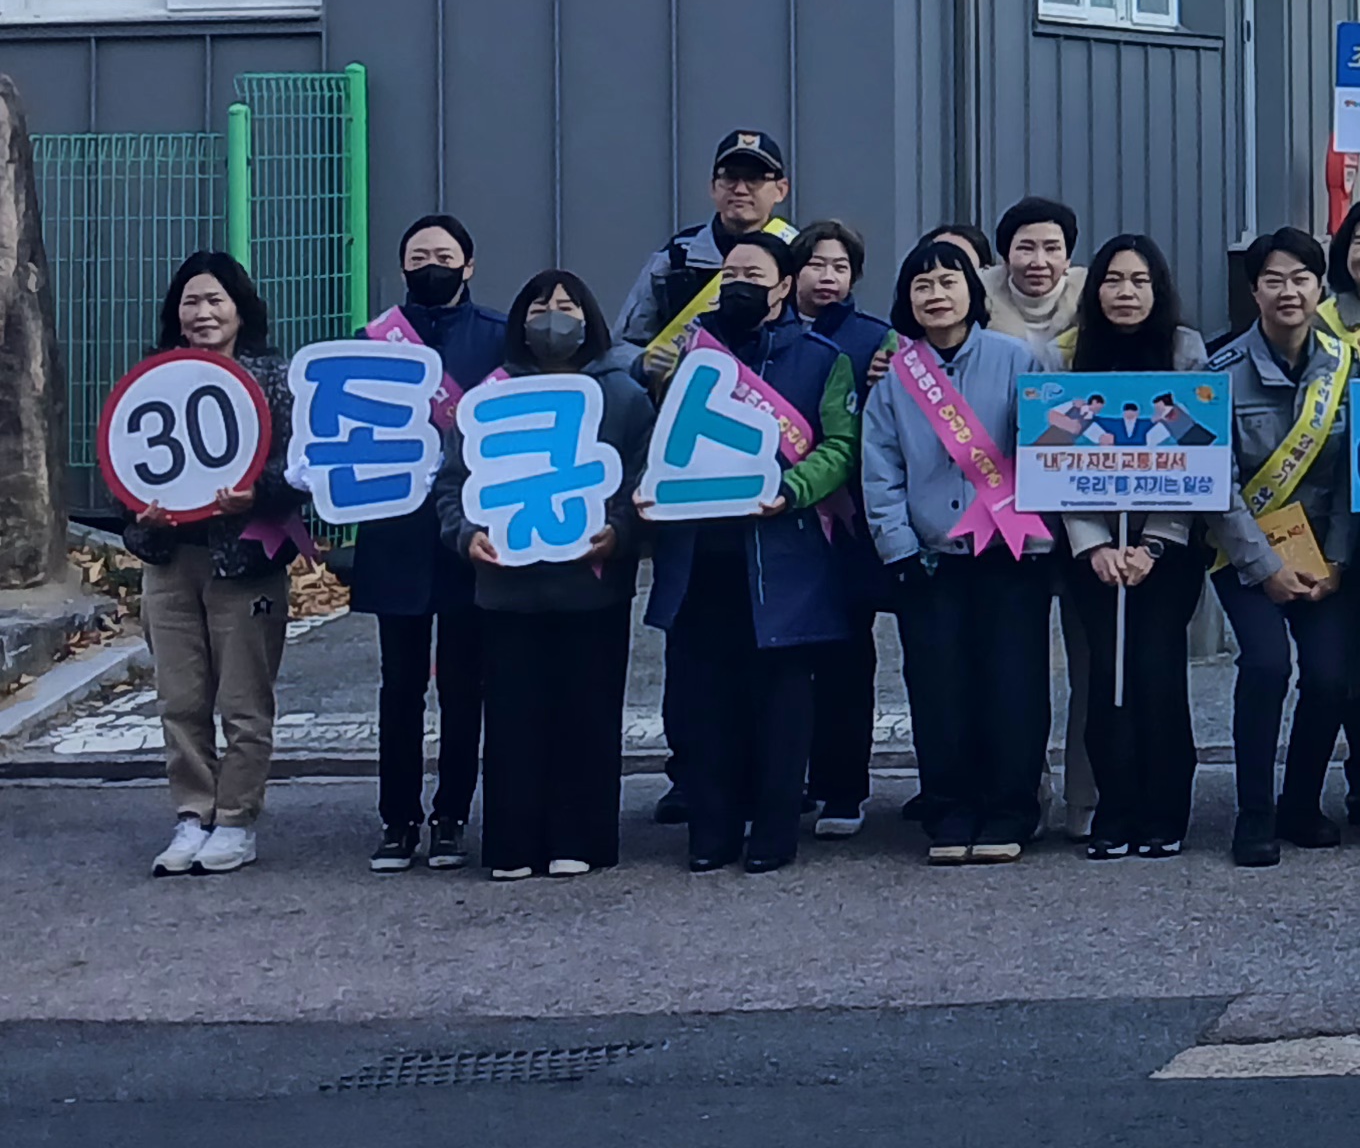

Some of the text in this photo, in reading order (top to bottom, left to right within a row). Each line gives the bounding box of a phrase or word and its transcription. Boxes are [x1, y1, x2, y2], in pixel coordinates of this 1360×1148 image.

[127, 383, 241, 486] 30
[304, 355, 427, 509] 존
[656, 362, 766, 504] 스
[1121, 452, 1153, 472] 교통
[1155, 451, 1188, 472] 질서
[1182, 475, 1214, 495] 일상
